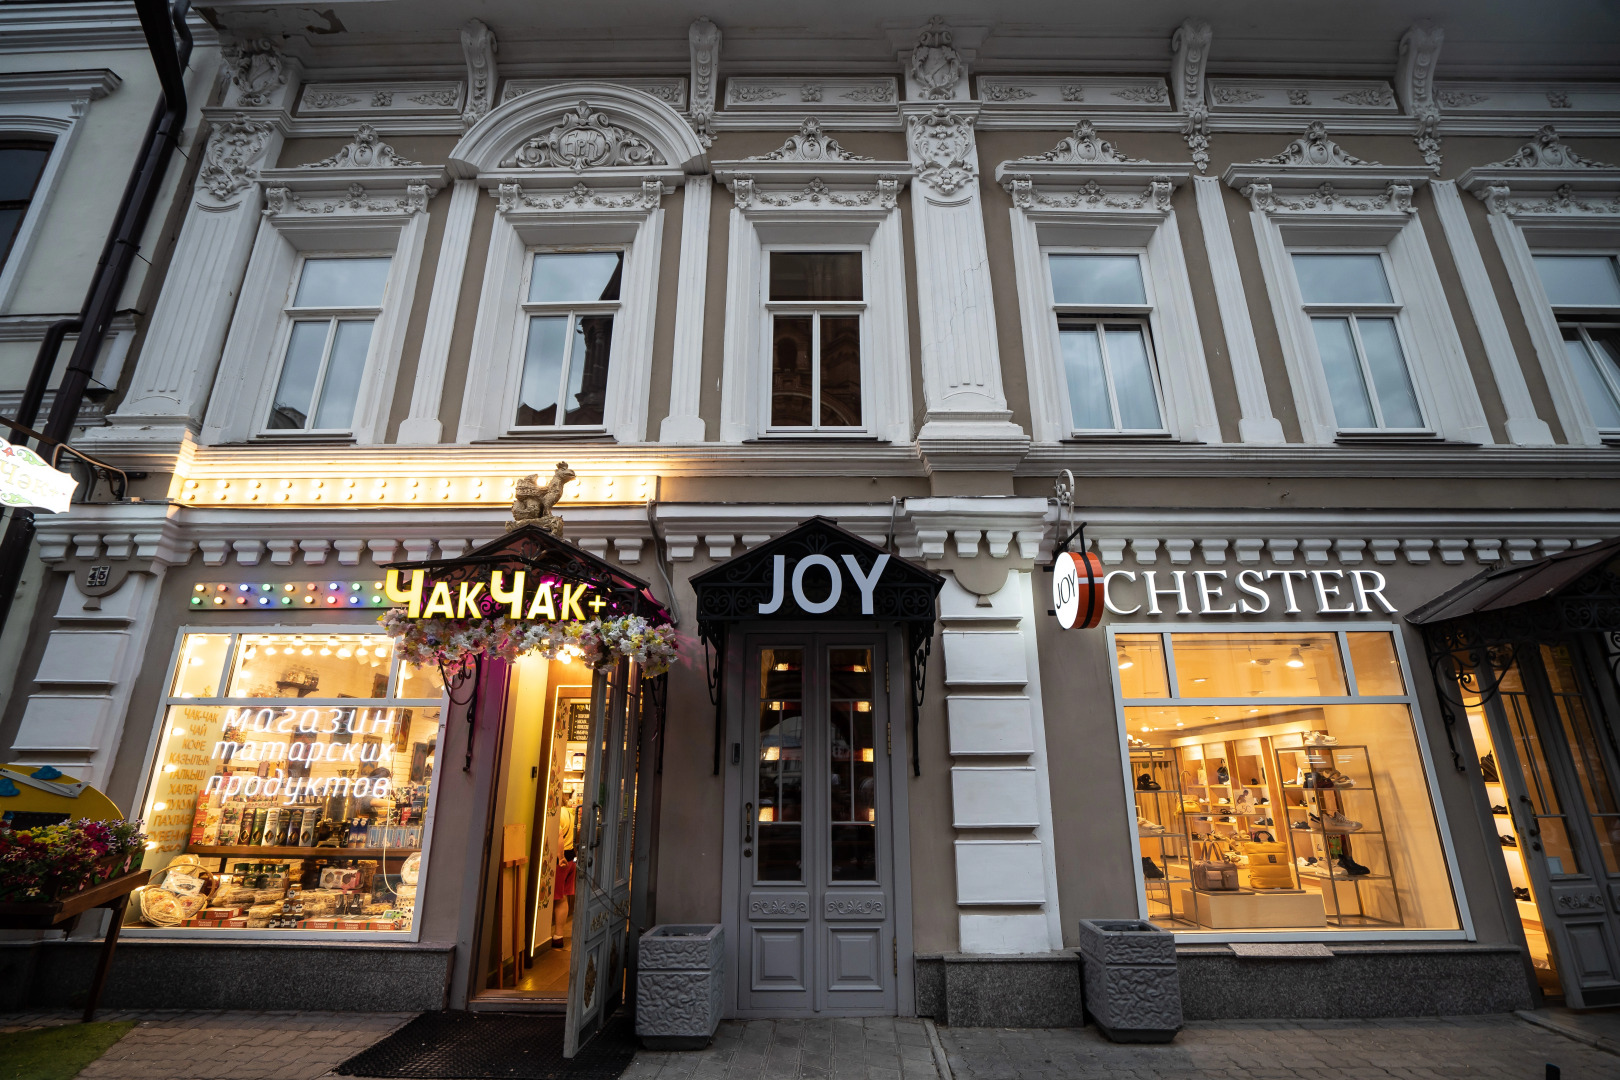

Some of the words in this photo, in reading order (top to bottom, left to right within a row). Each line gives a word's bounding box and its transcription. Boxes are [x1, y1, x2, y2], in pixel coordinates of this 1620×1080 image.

[88, 570, 107, 581] 45
[758, 553, 892, 615] JOY
[1055, 568, 1077, 610] JOY
[1102, 569, 1399, 616] CHESTER
[190, 724, 207, 736] ЧАЙ
[222, 709, 395, 734] магазин
[182, 739, 206, 751] КОФЕ
[211, 741, 395, 767] татарских
[204, 769, 390, 805] продуктов
